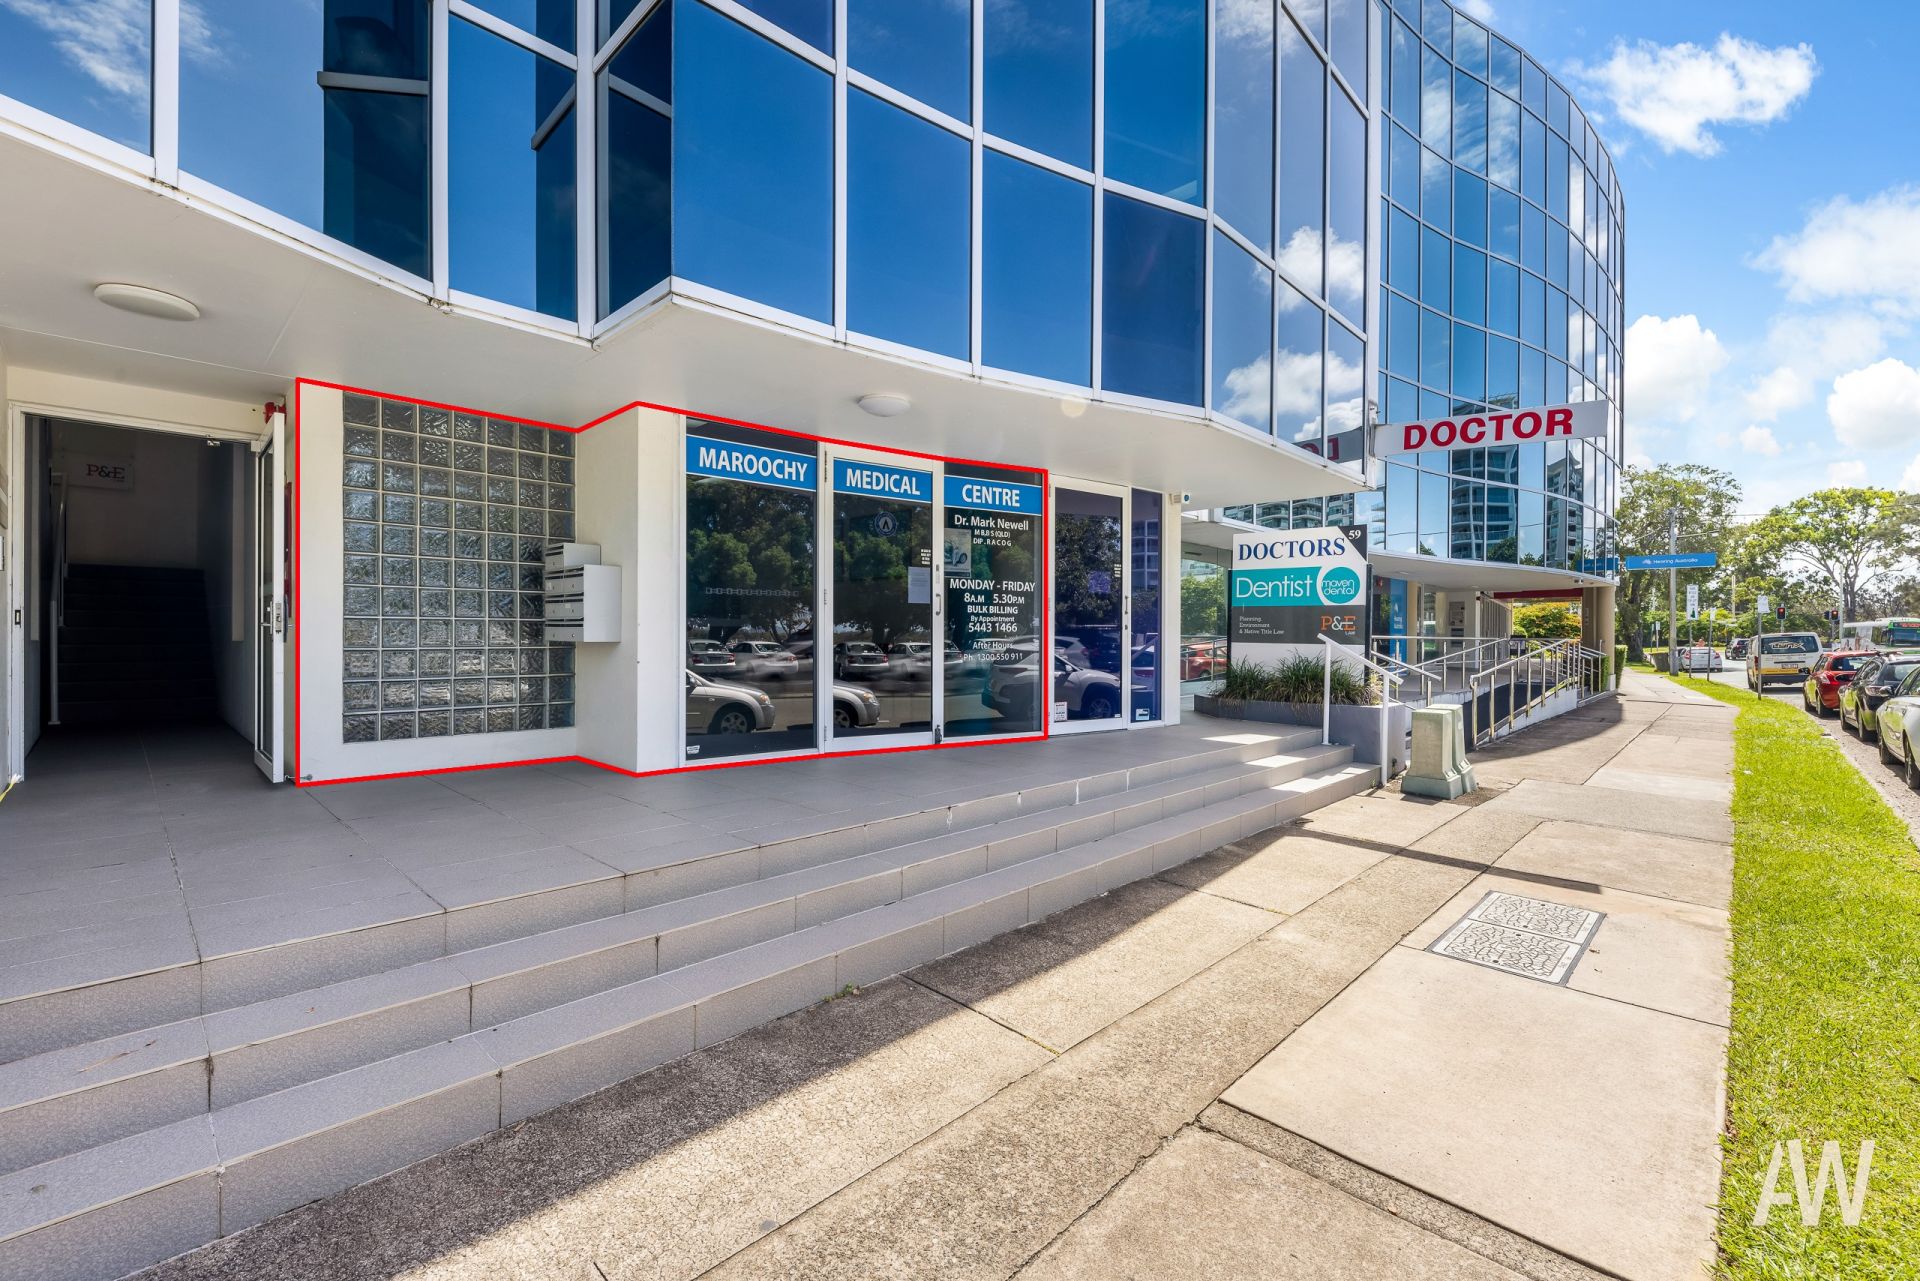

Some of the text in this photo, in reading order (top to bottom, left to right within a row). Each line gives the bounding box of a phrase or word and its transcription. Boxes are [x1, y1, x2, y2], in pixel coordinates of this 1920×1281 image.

[1403, 408, 1574, 450] DOCTOR
[86, 463, 125, 479] P&E
[699, 446, 808, 483] MAROOCHY
[846, 468, 920, 495] MEDICAL
[962, 484, 1020, 507] CENTRE
[954, 514, 1029, 531] Dr. Mark Newell
[1348, 529, 1362, 540] 59
[1238, 537, 1346, 561] DOCTORS
[949, 578, 995, 590] MONDAY
[1002, 581, 1036, 592] FRIDAY
[1236, 574, 1313, 598] Dentist
[1321, 579, 1355, 588] maven
[1323, 586, 1355, 596] dental
[967, 605, 1018, 614] BULK BILLING
[970, 615, 1015, 623] By Appointment
[1320, 615, 1356, 631] P&E
[968, 622, 1018, 633] 5443 1466
[972, 641, 1013, 650] After Hours
[977, 652, 995, 661] 1300
[996, 652, 1010, 661] 550
[1010, 651, 1023, 660] 911
